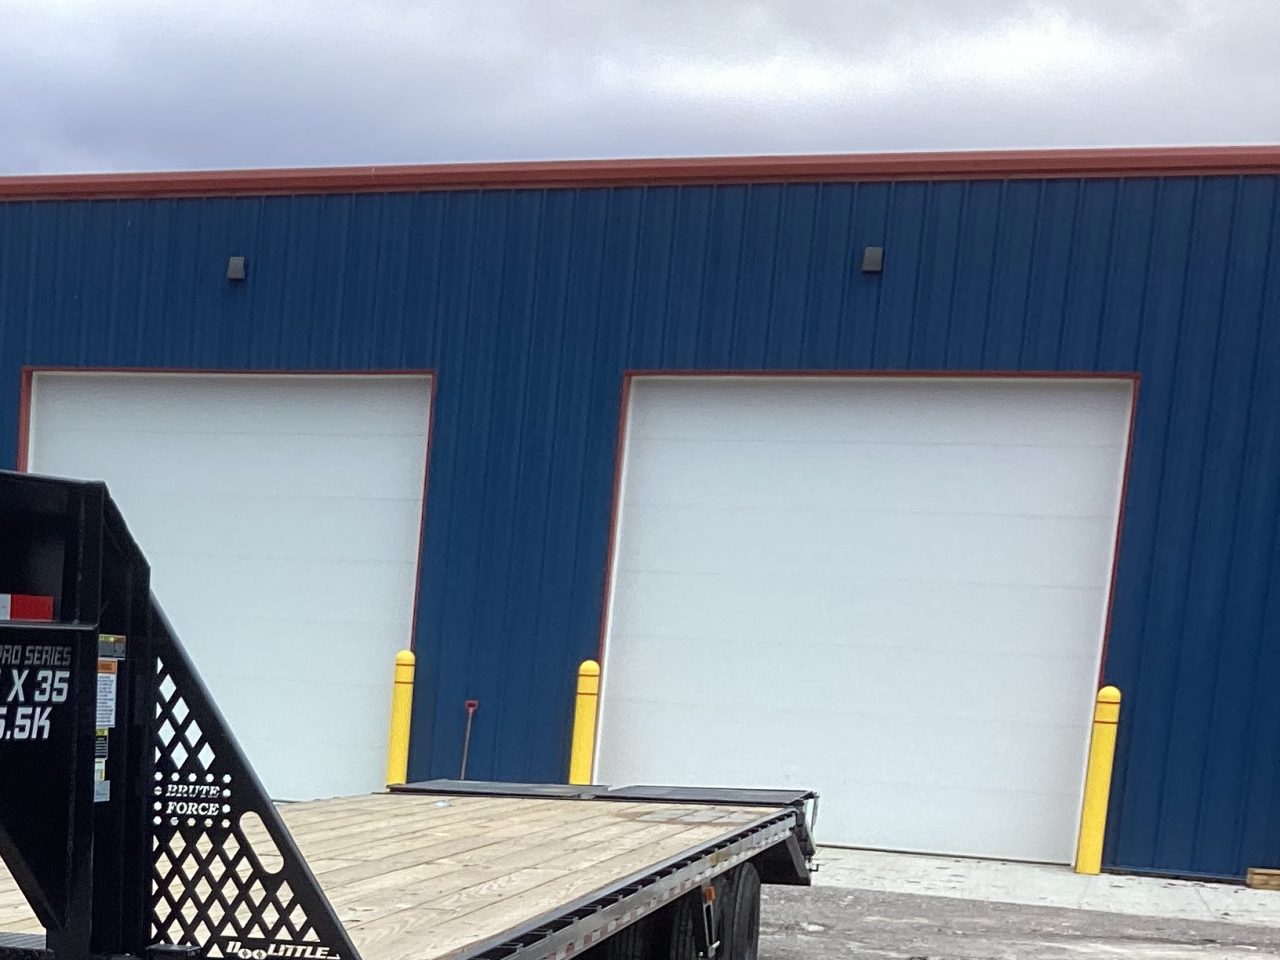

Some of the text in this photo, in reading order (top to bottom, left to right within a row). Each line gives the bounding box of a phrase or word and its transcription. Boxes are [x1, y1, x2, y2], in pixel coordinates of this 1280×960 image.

[24, 645, 72, 666] SERIES
[7, 669, 29, 702] X
[34, 670, 70, 702] 35
[165, 784, 220, 798] BRUTE
[166, 801, 219, 815] FORCE
